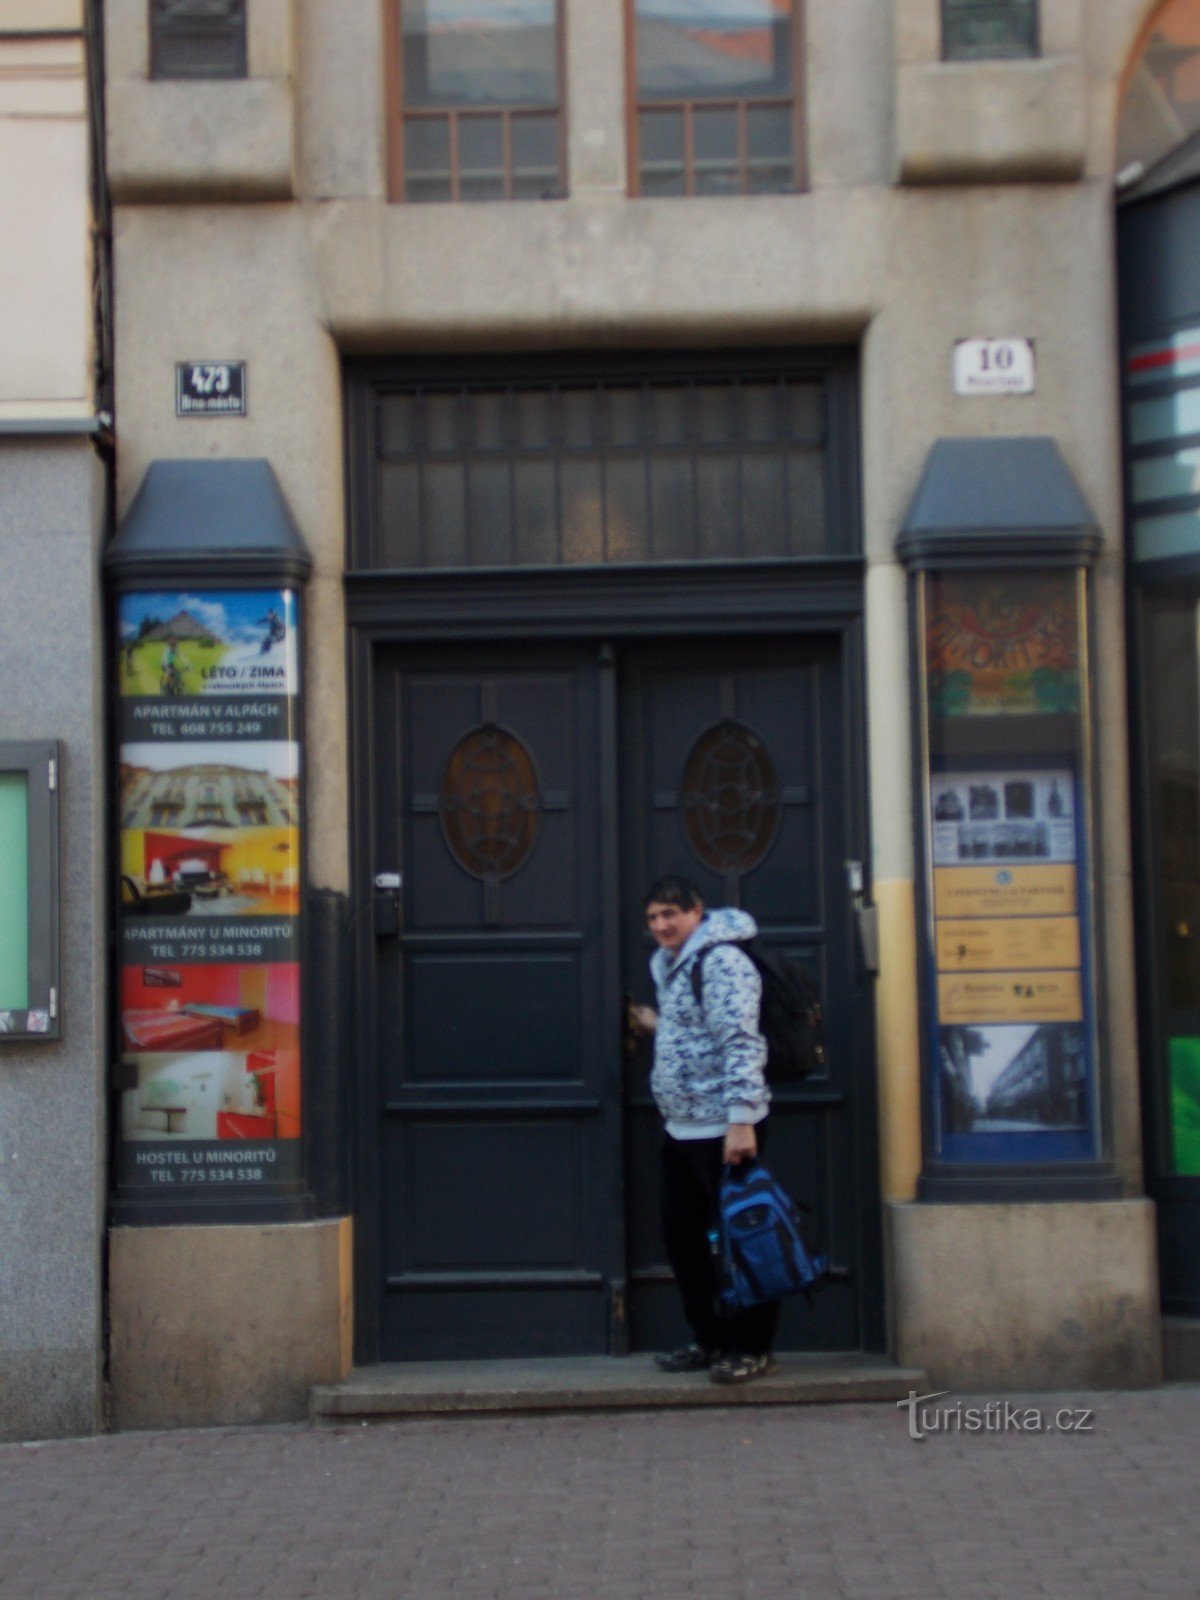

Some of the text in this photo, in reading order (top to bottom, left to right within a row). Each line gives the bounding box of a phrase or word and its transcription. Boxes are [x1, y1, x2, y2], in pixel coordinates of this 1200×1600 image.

[981, 346, 1014, 371] 10
[191, 366, 230, 393] 473
[249, 665, 285, 679] ZIMA
[133, 703, 279, 718] APARTMÁN V ALPÁCH
[180, 723, 204, 735] 608
[236, 722, 261, 733] 249
[124, 923, 291, 940] APARTMÁNY U MINORITŮ
[181, 945, 206, 957] 775
[209, 945, 234, 957] 534
[237, 944, 262, 956] 538
[136, 1148, 276, 1164] HOSTEL U MINORITŮ
[180, 1170, 205, 1181] 775
[209, 1169, 234, 1181] 534
[236, 1169, 262, 1181] 538
